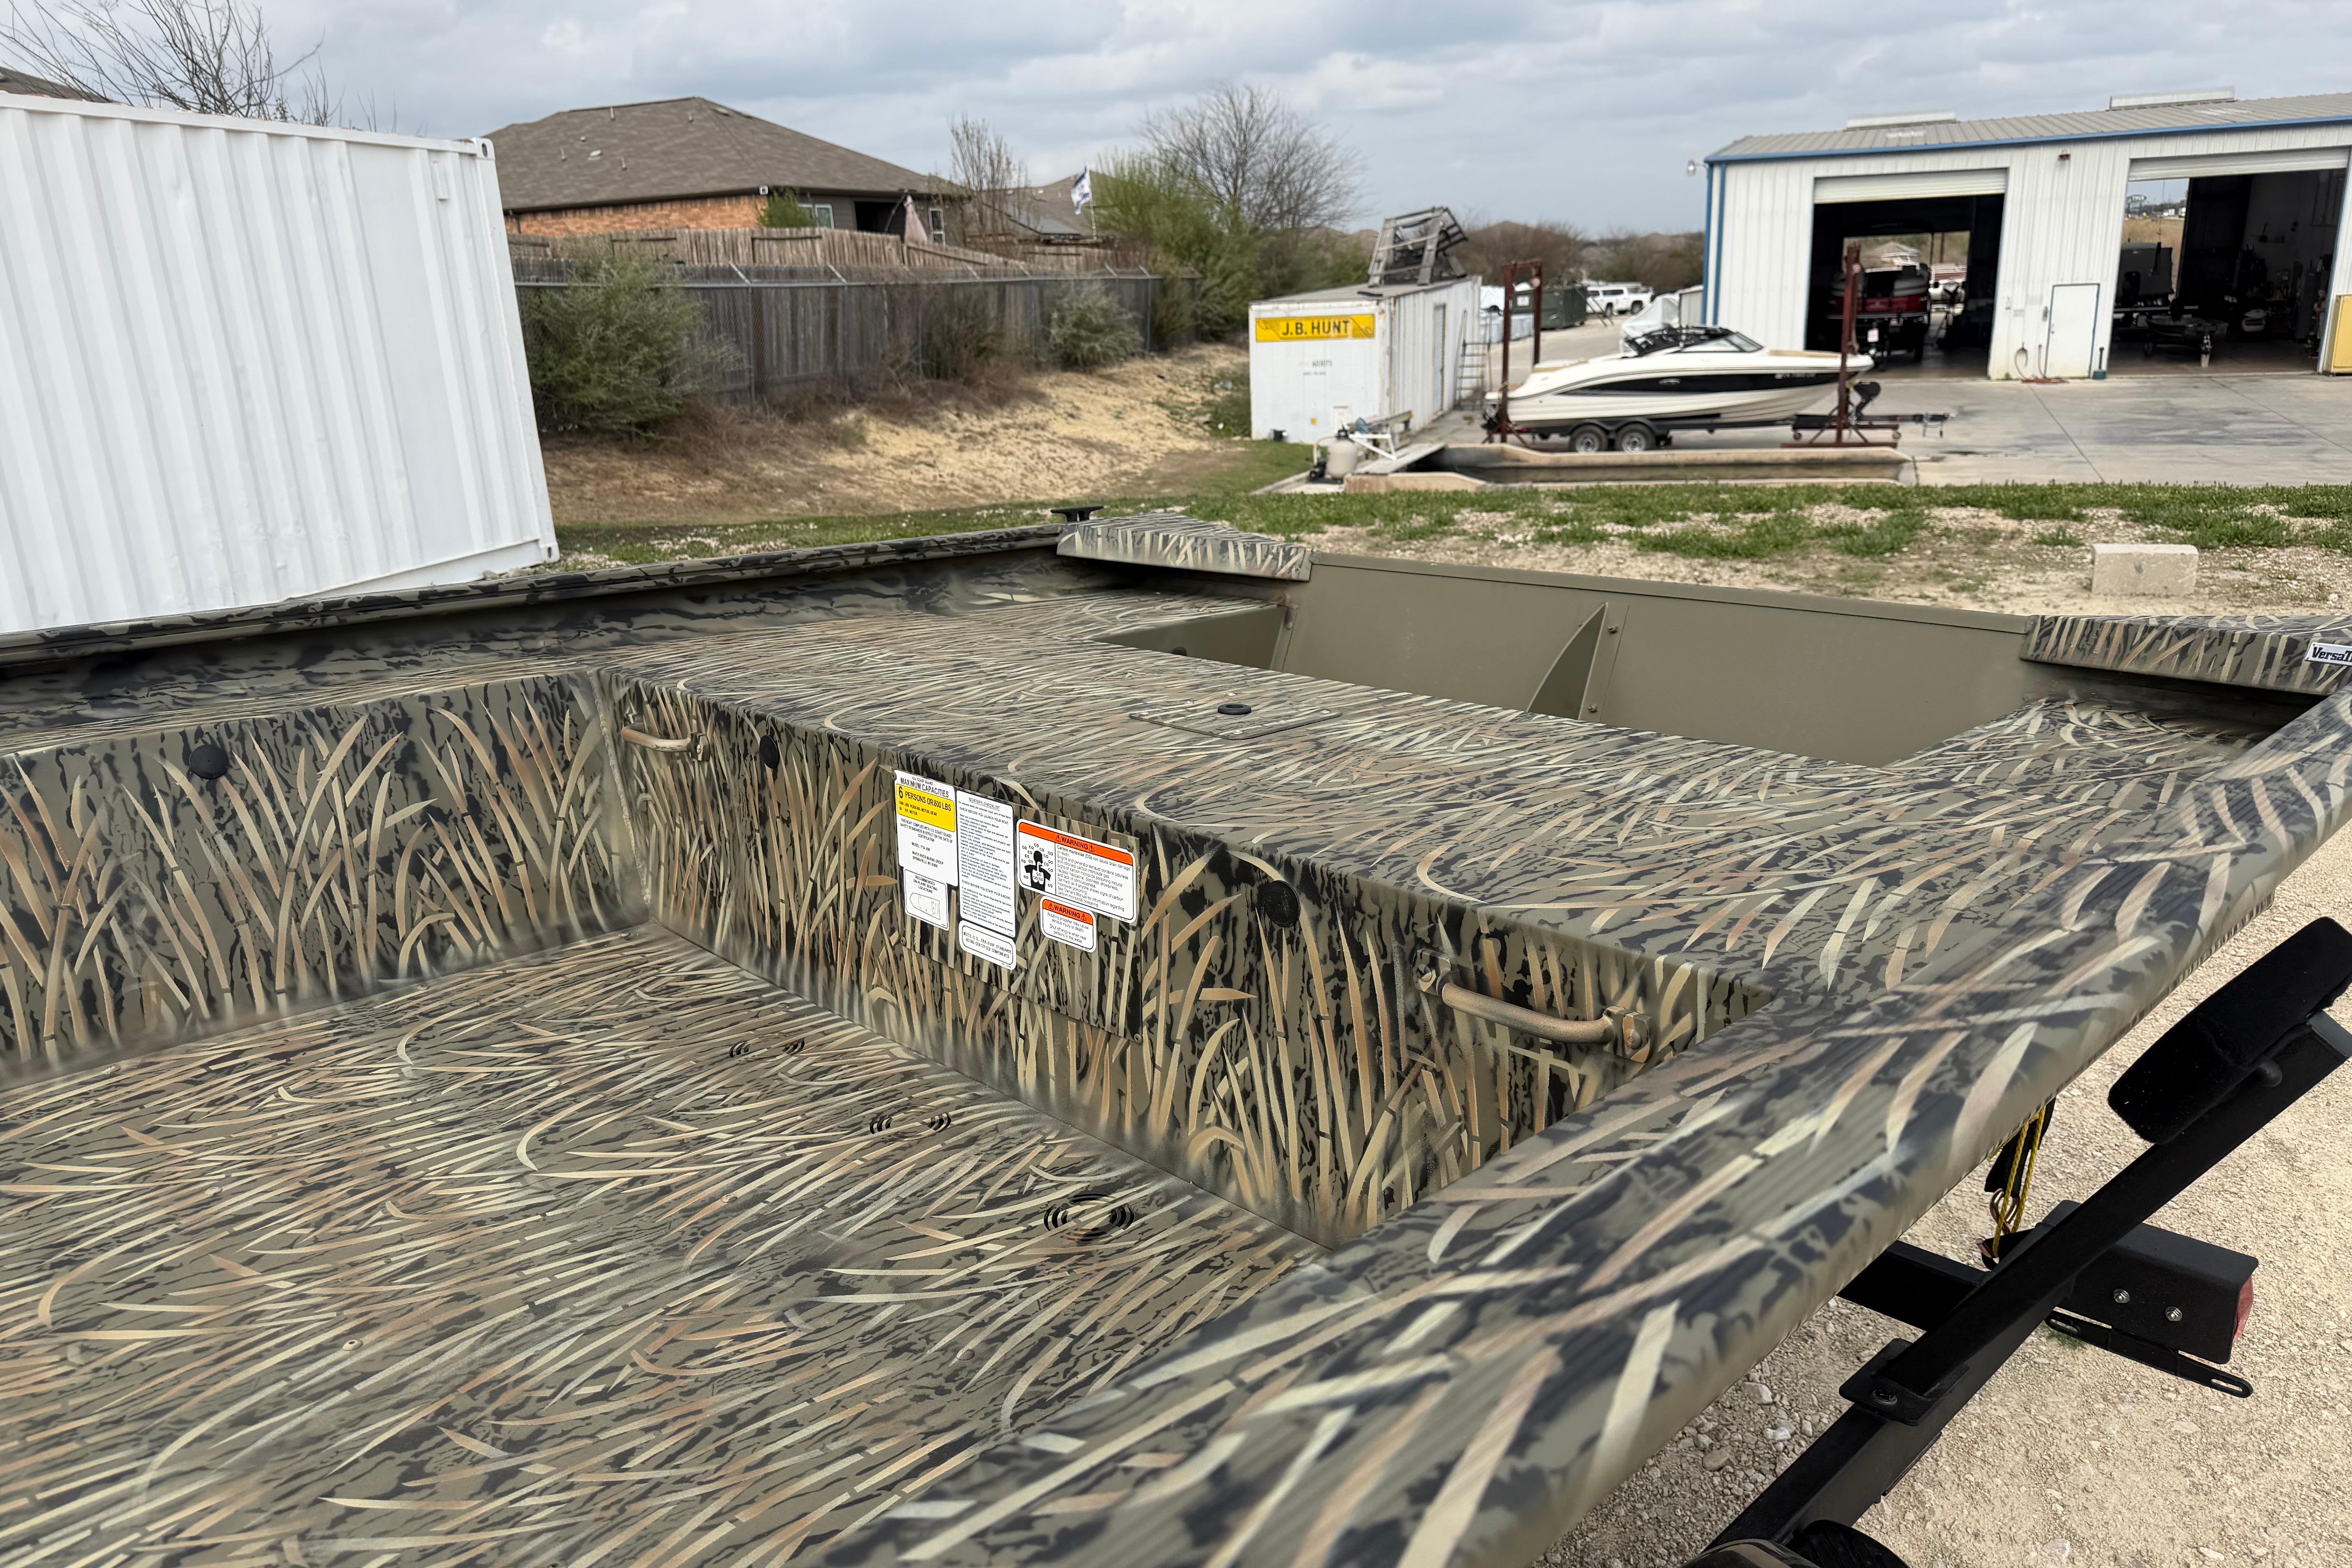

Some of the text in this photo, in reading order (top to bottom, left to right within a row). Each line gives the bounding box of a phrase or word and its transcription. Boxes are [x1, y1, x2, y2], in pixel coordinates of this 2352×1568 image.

[1282, 320, 1350, 336] J.B. HUNT
[2312, 646, 2352, 662] VersaT
[901, 777, 949, 798] MAXIMUM CAPACITIES
[899, 786, 903, 799] 6
[905, 791, 926, 803] PERSONS
[927, 798, 934, 806] OR
[942, 803, 951, 811] LBS
[1062, 837, 1088, 849] WARNING
[1096, 876, 1111, 884] poisoning
[1054, 905, 1080, 918] WARNING
[1110, 904, 1125, 912] regarding
